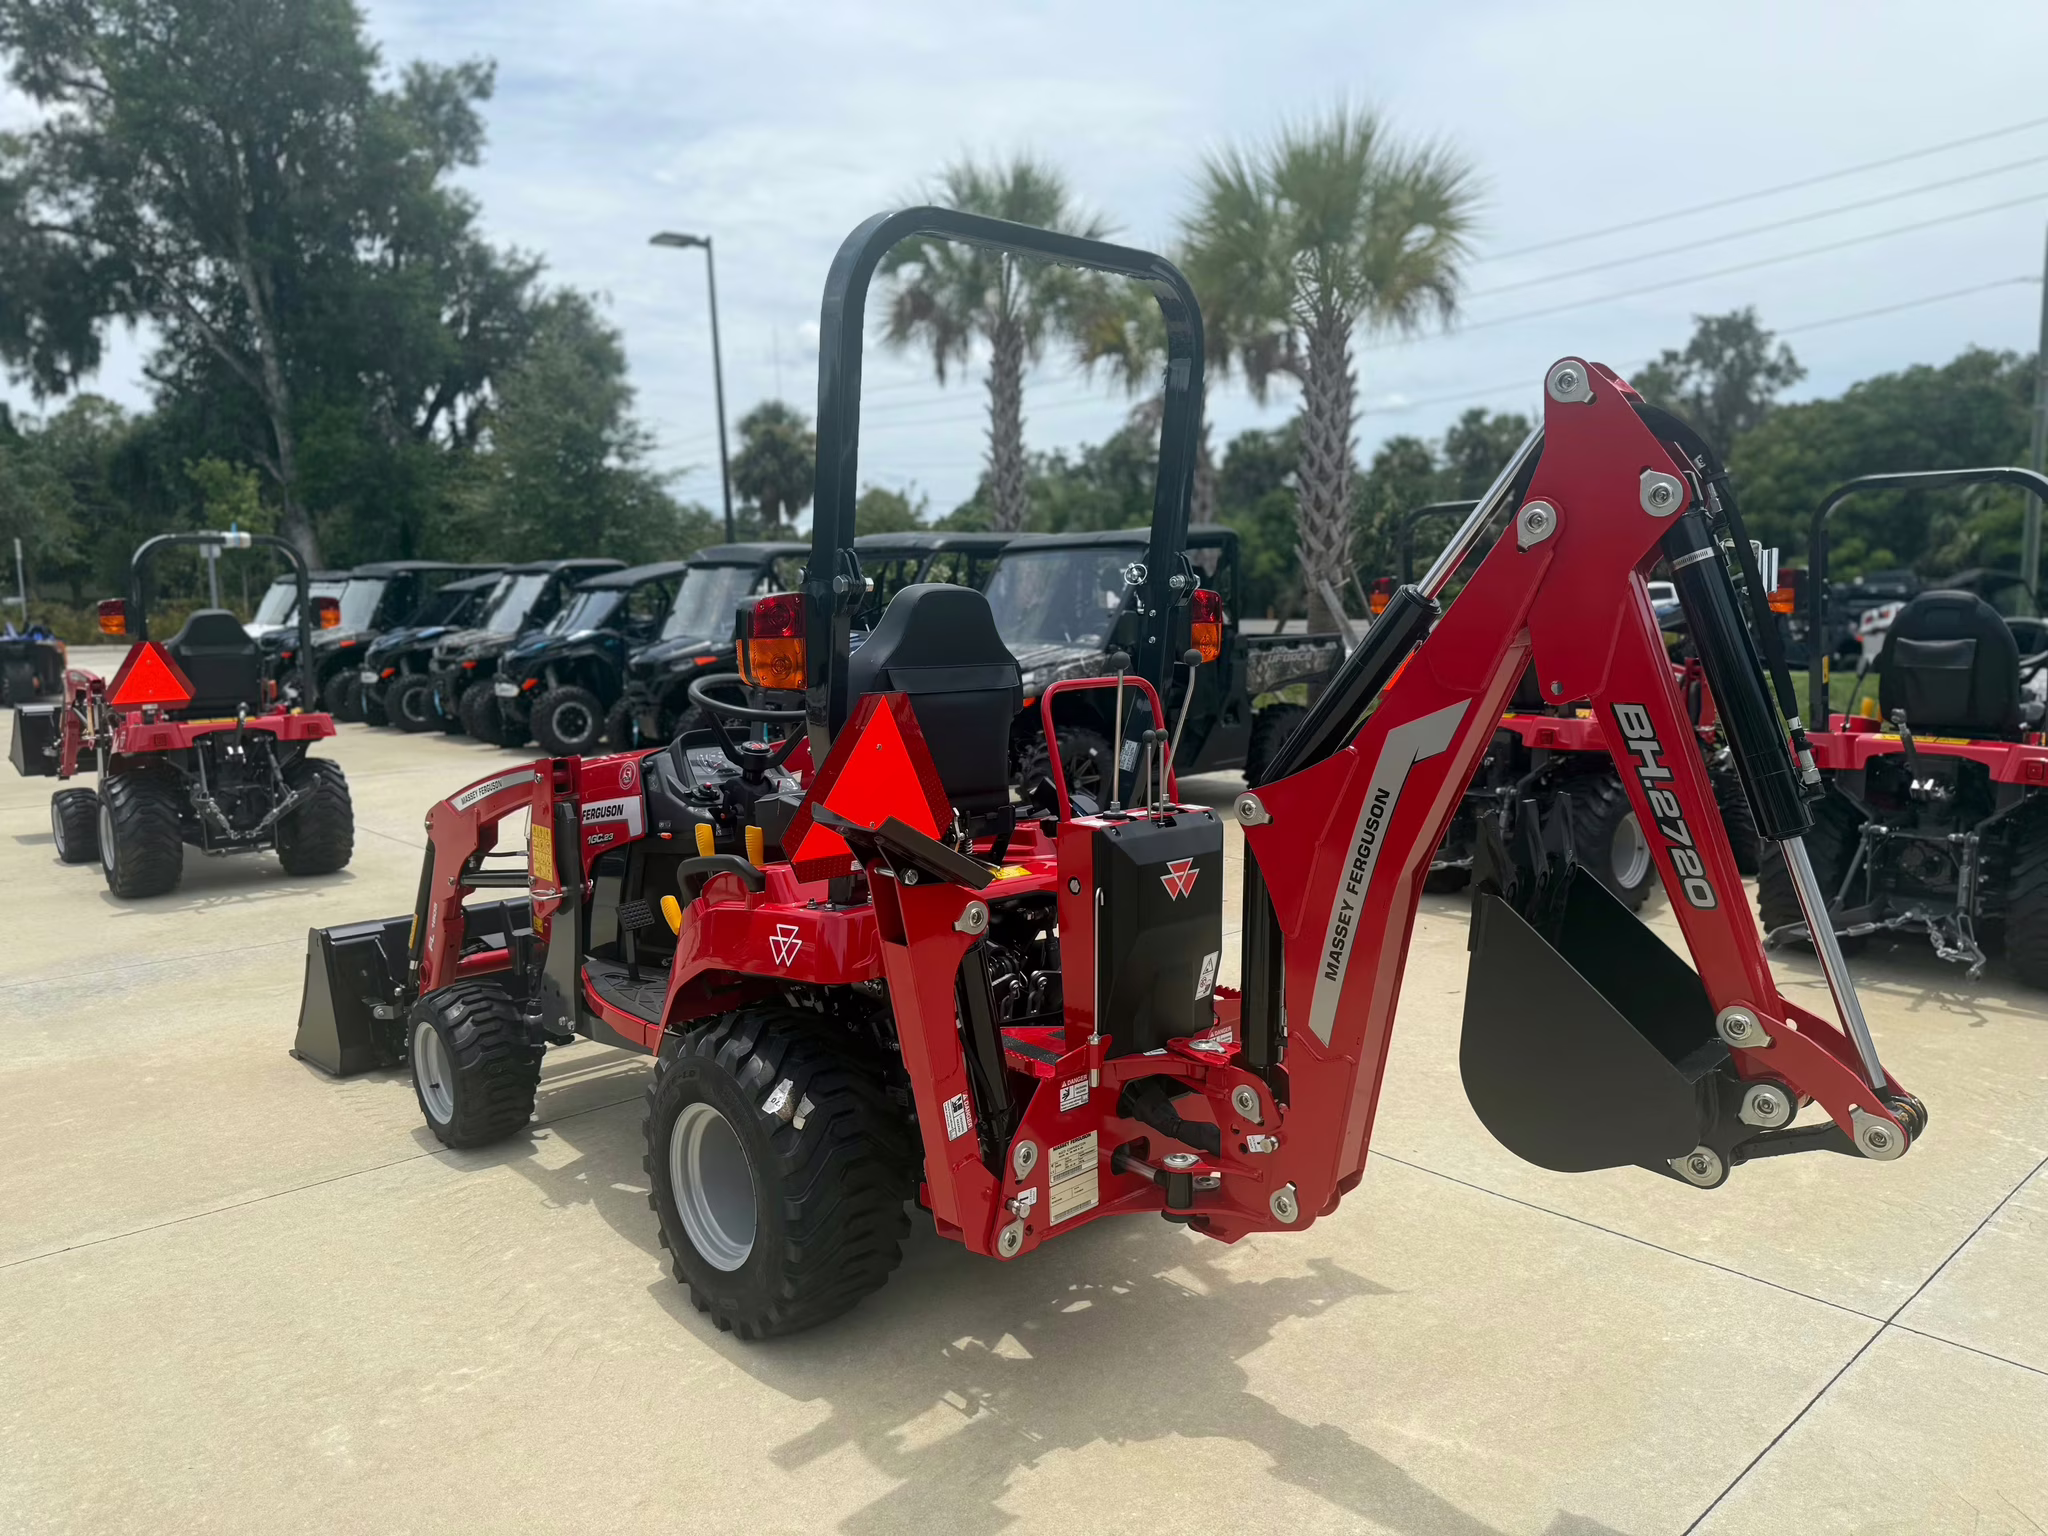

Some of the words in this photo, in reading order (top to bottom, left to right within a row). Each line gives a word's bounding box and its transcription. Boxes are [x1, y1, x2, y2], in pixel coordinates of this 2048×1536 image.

[461, 786, 478, 805] MASSEY
[478, 780, 503, 798] FERGUSON
[582, 804, 624, 821] FERGUSON
[1611, 703, 1717, 910] BH.2720
[1325, 898, 1354, 981] MASSEY
[1346, 787, 1390, 895] FERGUSON
[1215, 1026, 1232, 1036] DANGER
[1067, 1074, 1088, 1086] DANGER
[963, 1100, 973, 1129] DANGER
